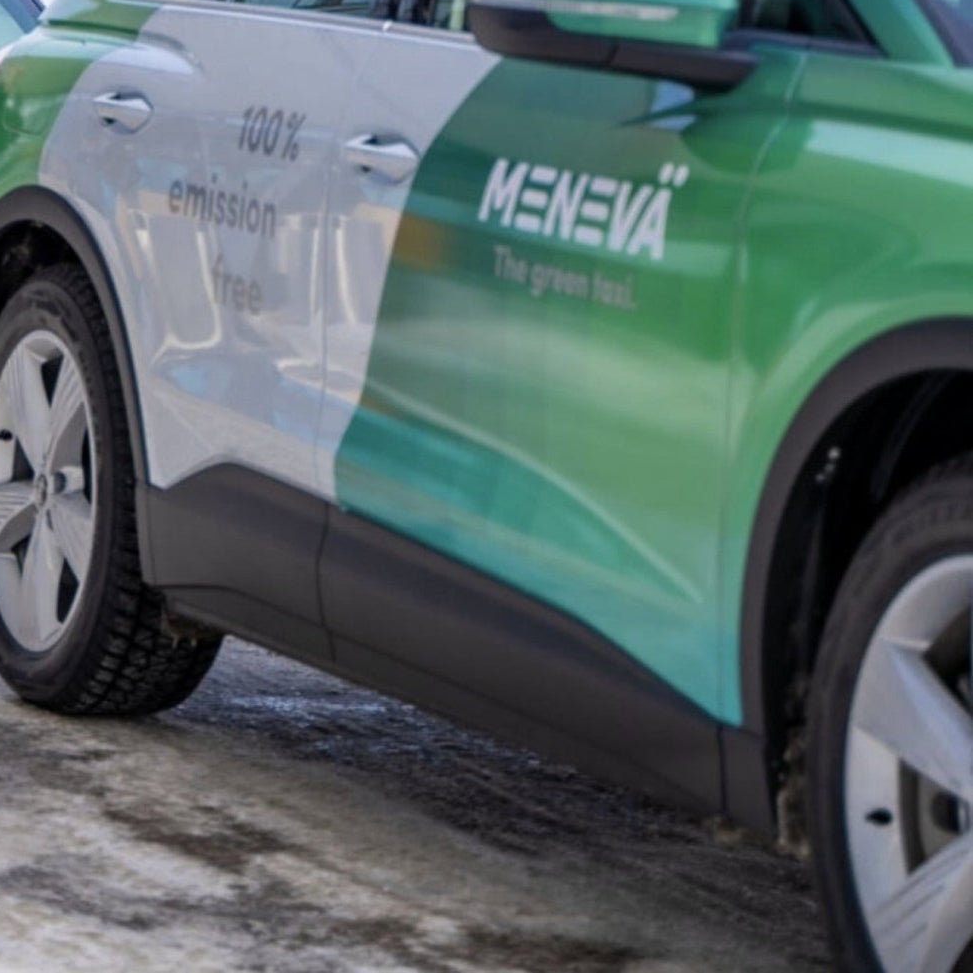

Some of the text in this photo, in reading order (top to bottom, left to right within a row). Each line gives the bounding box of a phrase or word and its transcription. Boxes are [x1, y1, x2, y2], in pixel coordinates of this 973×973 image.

[238, 105, 306, 161] 100%
[168, 173, 277, 238] emission
[478, 157, 689, 260] MENEVÄ
[211, 253, 262, 316] free
[494, 244, 528, 283] The
[530, 263, 590, 298] green
